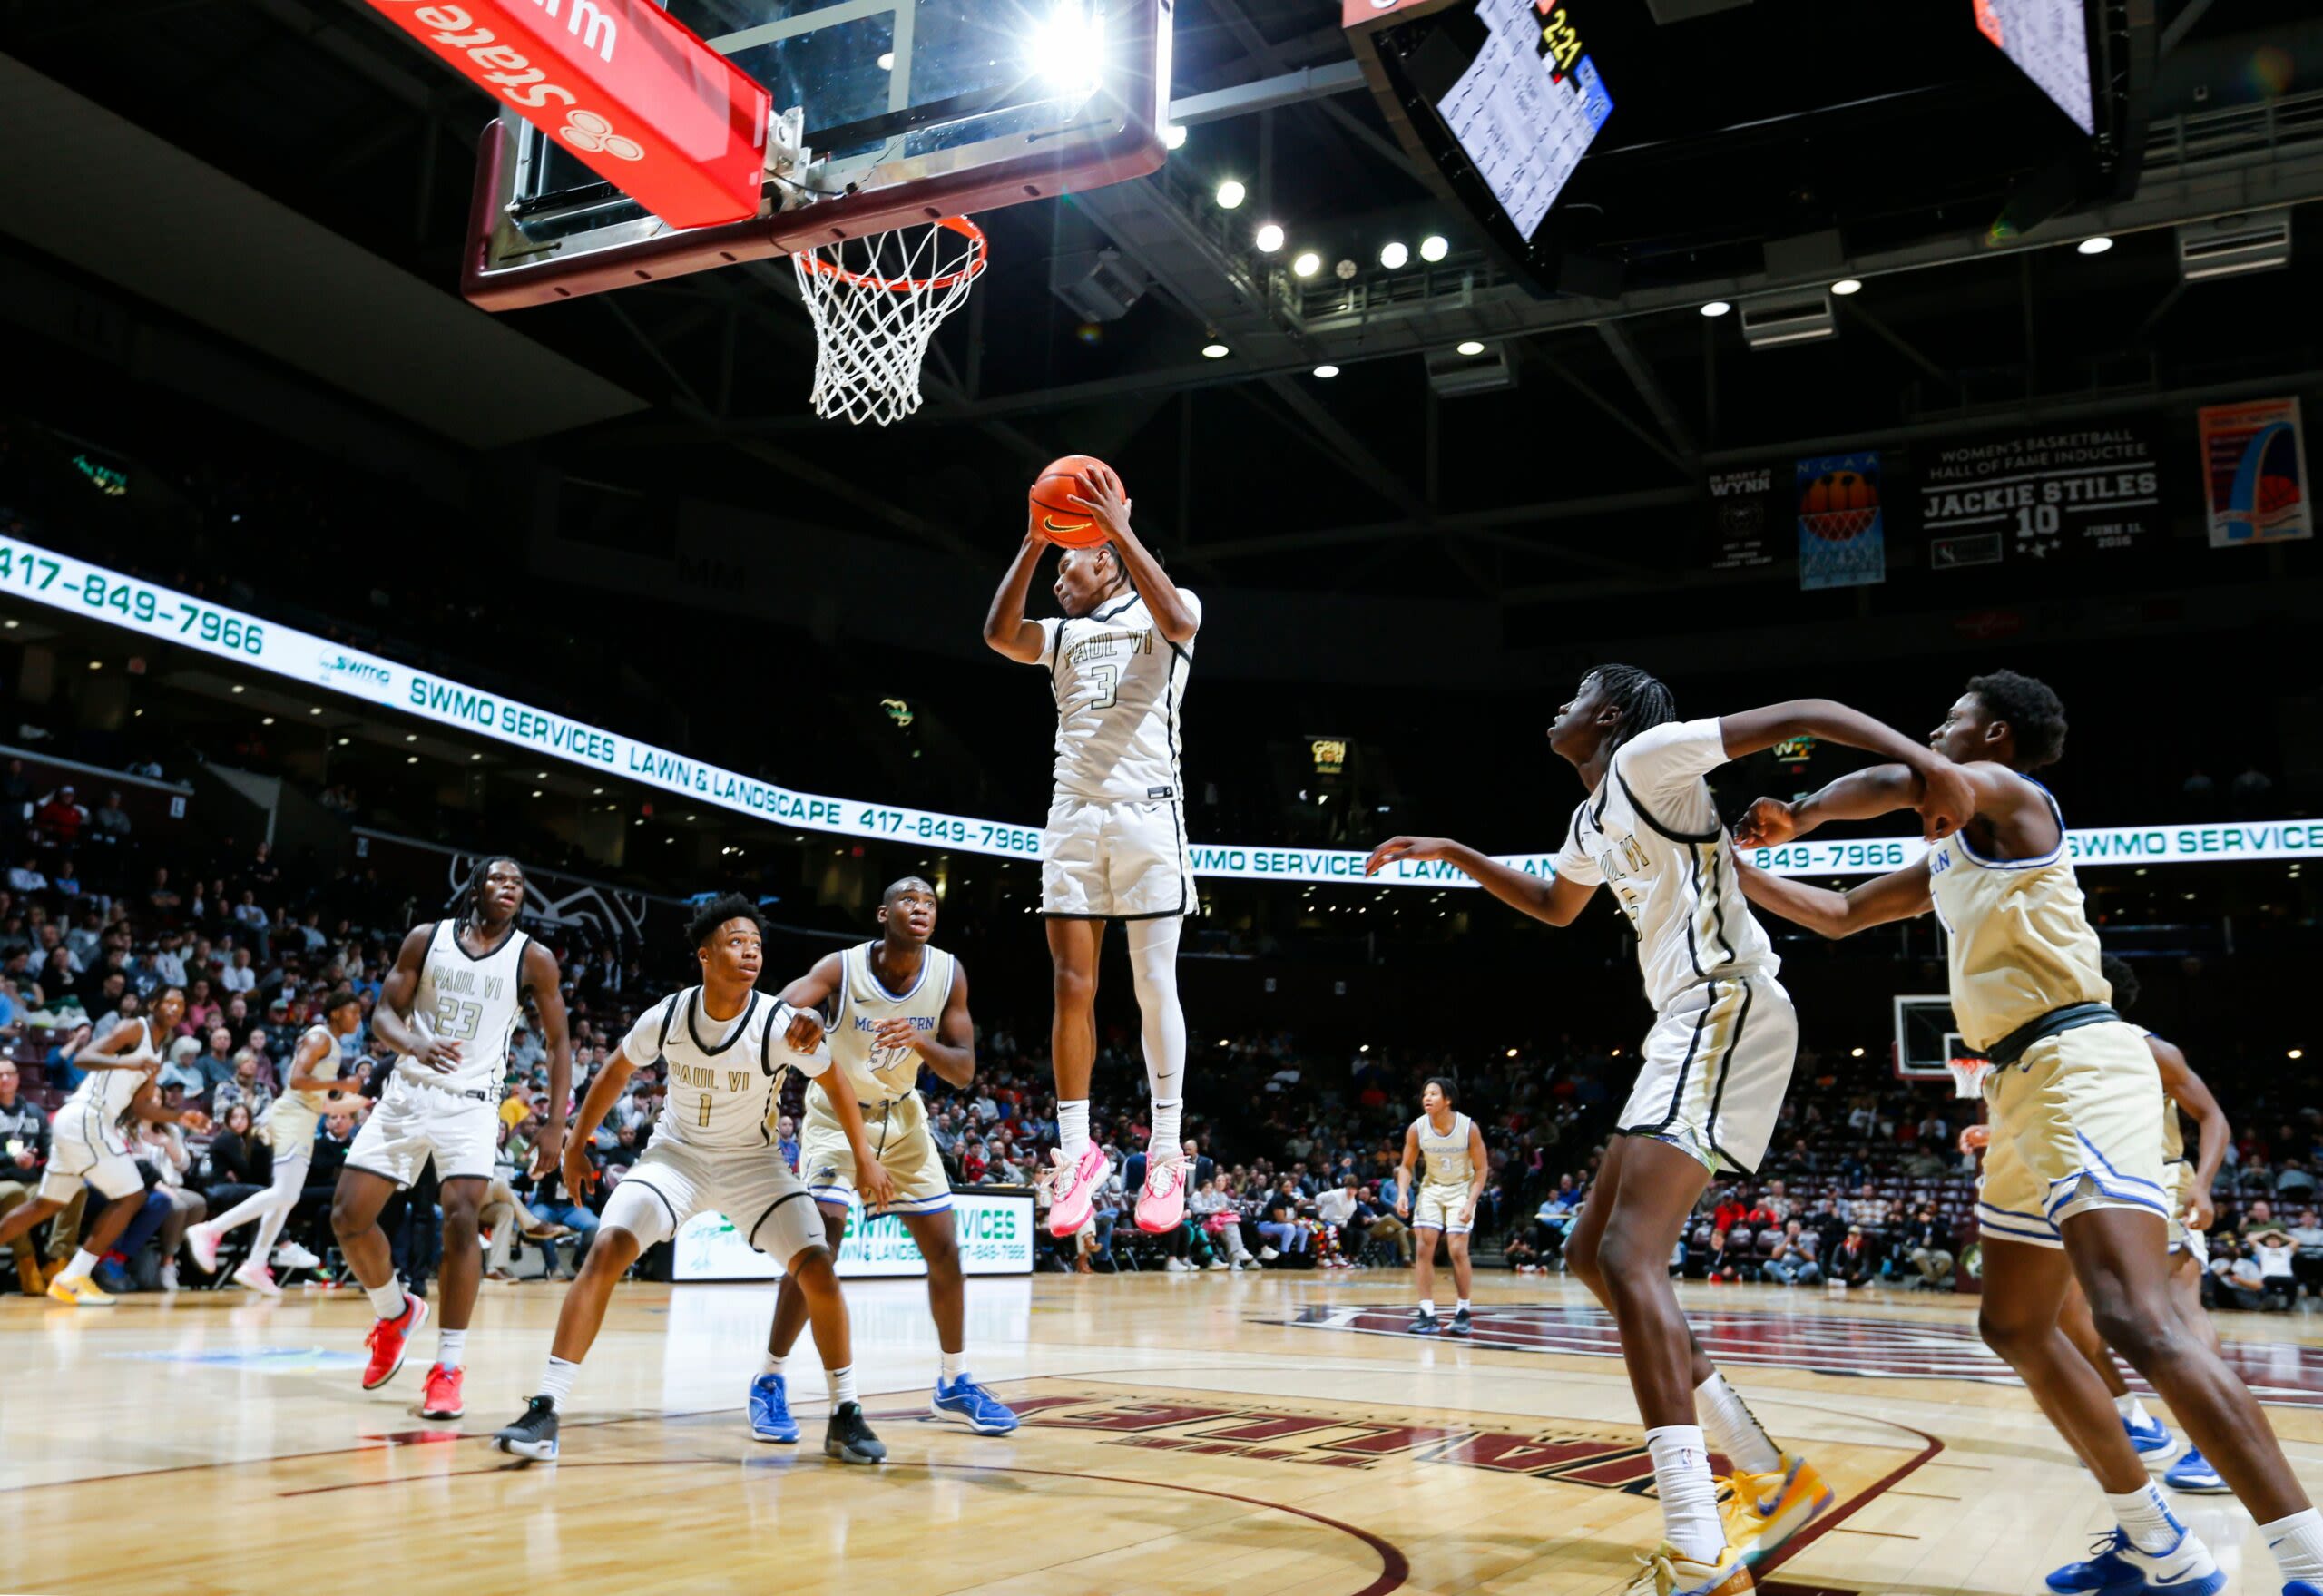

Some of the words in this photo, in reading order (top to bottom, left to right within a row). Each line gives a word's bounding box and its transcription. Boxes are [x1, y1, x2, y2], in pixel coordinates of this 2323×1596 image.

[414, 5, 577, 107] State
[1544, 9, 1581, 70] 2:21
[1929, 463, 1973, 480] HALL
[1976, 459, 1999, 474] OF
[2004, 452, 2049, 470] FAME
[2054, 442, 2149, 463] INDUCTEE
[1941, 439, 2024, 463] WOMEN'S
[2025, 427, 2134, 452] BASKETBALL
[1710, 477, 1771, 497] WYNN
[1923, 483, 2035, 518] JACKIE
[2043, 473, 2159, 504] STILES
[2015, 504, 2061, 538] 10
[2083, 524, 2123, 537] JUNE
[1064, 632, 1117, 670] PAUL
[1126, 628, 1152, 654] VI
[1091, 664, 1117, 710] 3
[410, 677, 495, 727] SWMO
[501, 706, 614, 763] SERVICES
[630, 746, 691, 787] LAWN
[695, 769, 707, 791] &
[713, 777, 842, 825] LANDSCAPE
[859, 809, 1039, 853] 417-849-7966
[1190, 849, 1245, 871] WMO
[431, 965, 475, 996] PAUL
[484, 975, 504, 1001] VI
[436, 996, 483, 1041] 23
[670, 1059, 720, 1090] PAUL
[729, 1071, 750, 1092] VI
[698, 1093, 712, 1128] 1
[1440, 1157, 1452, 1172] 3
[956, 1209, 1015, 1239] VICES
[1082, 1391, 1339, 1416] CONFERENCE
[1095, 1435, 1380, 1470] THE
